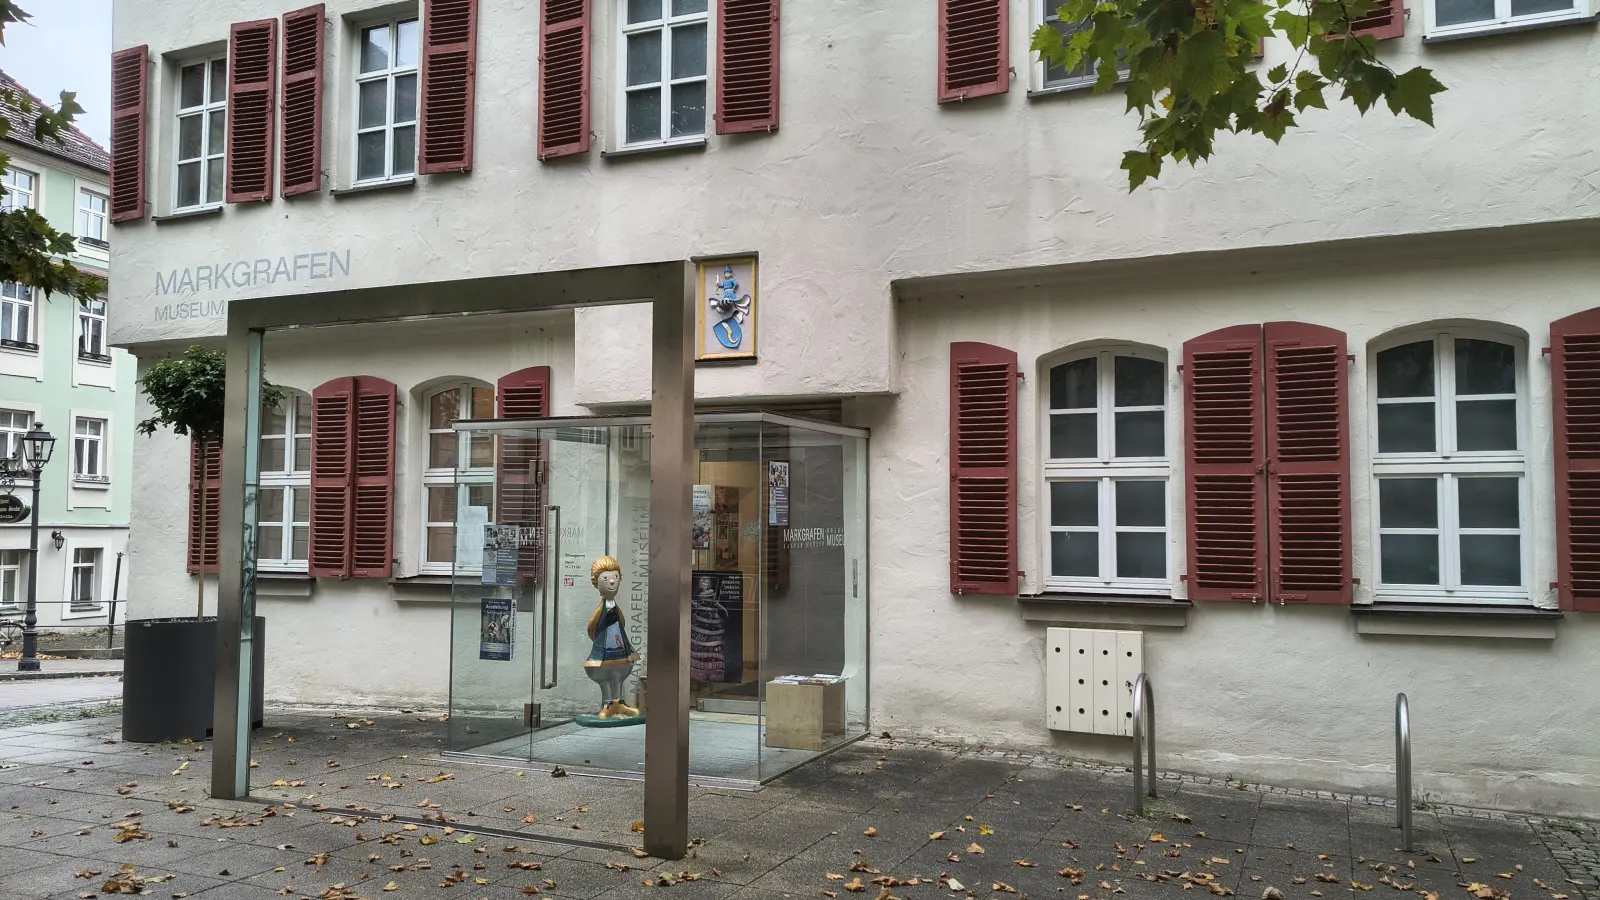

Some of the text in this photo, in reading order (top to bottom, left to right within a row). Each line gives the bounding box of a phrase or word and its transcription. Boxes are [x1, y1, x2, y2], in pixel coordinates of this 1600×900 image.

[155, 249, 351, 295] MARKGRAFEN
[154, 300, 225, 322] MUSEUM
[631, 505, 639, 577] ANSBACH
[783, 527, 825, 542] MARKGRAFEN
